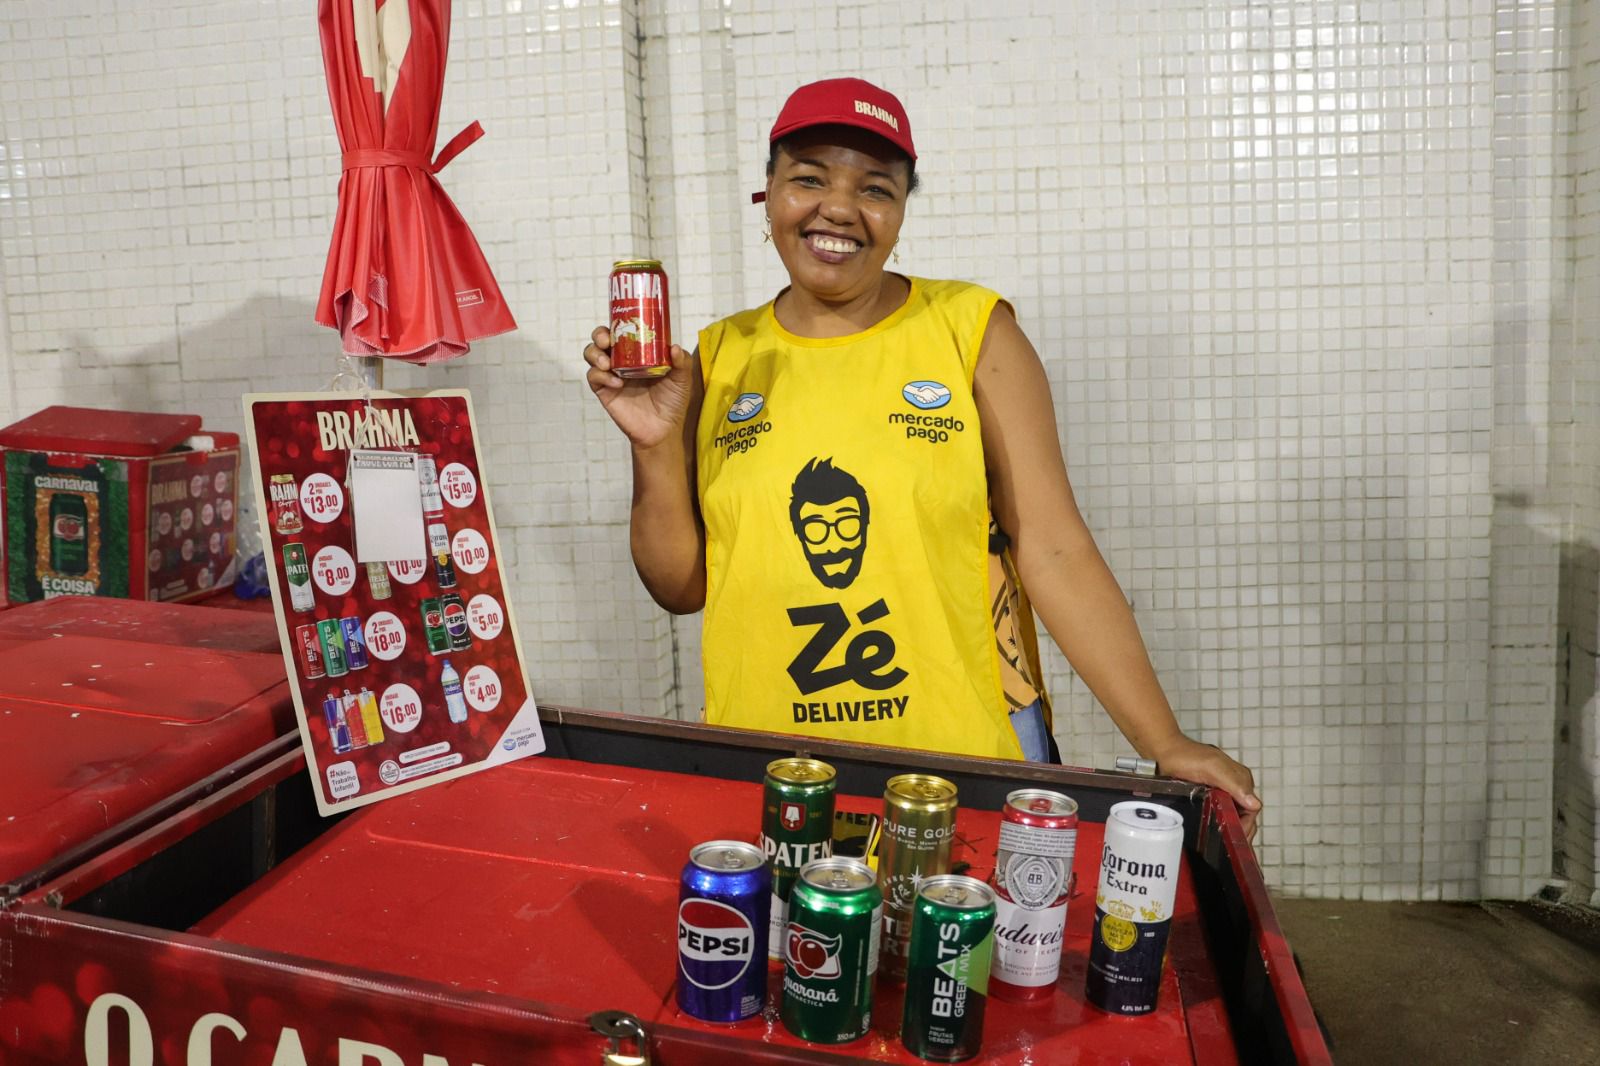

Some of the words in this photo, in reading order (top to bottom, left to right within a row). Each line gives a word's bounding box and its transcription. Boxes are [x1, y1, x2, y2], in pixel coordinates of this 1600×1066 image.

[854, 100, 899, 132] BRAHMA
[316, 408, 420, 451] BRAHMA
[888, 412, 964, 432] mercado
[714, 421, 772, 448] mercado
[906, 425, 949, 444] pago
[726, 437, 758, 459] pago
[446, 471, 452, 482] 2
[308, 483, 315, 495] 2
[448, 482, 472, 499] 15,00
[310, 494, 338, 513] 13,00
[460, 547, 485, 566] 10,00
[42, 575, 51, 590] É
[52, 578, 95, 594] COISA
[325, 566, 349, 586] 8,00
[372, 622, 379, 633] 2
[478, 612, 499, 631] 5,00
[302, 630, 314, 662] BEATS
[324, 625, 336, 659] BEATS
[345, 622, 356, 654] BEATS
[374, 631, 401, 652] 18,00
[786, 598, 909, 696] Zé
[477, 683, 497, 702] 4,00
[390, 702, 417, 725] 16,00
[792, 696, 909, 723] DELIVERY
[332, 776, 356, 786] Trabalho
[334, 783, 355, 793] Infantil
[883, 818, 917, 838] PURE
[923, 824, 956, 839] GOLD
[1102, 842, 1166, 879] Corona
[1106, 869, 1147, 895] Extra
[679, 922, 749, 956] PEPSI
[959, 944, 972, 973] MIX
[931, 923, 960, 1018] BEATS
[954, 976, 968, 1018] GREEN
[928, 1030, 954, 1039] FRUTAS
[928, 1036, 954, 1045] VERDES
